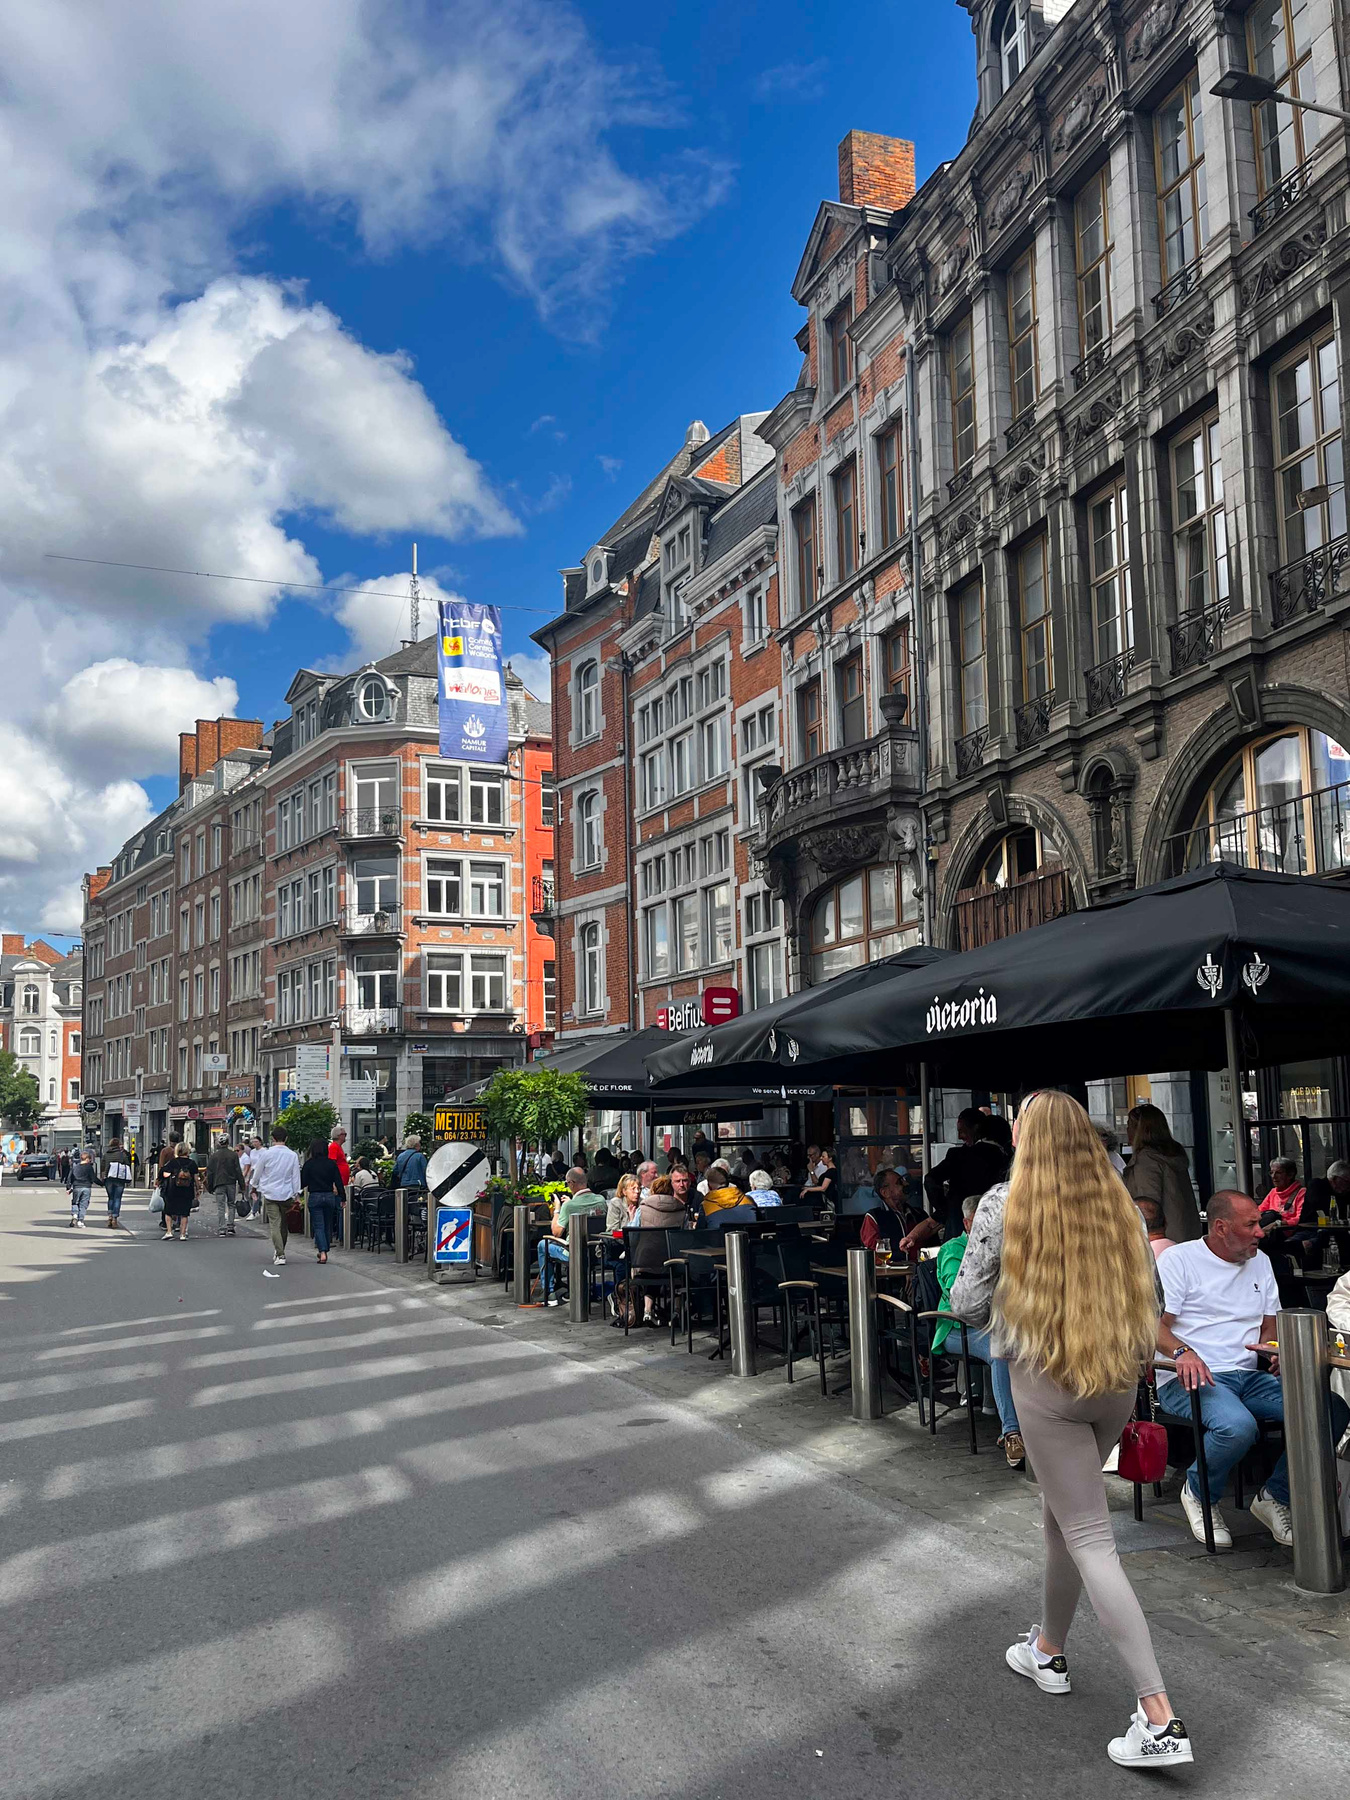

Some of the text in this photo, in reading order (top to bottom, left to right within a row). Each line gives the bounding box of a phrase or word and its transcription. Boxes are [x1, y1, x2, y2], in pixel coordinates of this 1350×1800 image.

[468, 643, 495, 652] Central
[469, 650, 498, 660] Wallonie
[461, 738, 487, 746] NAMUR
[461, 744, 487, 752] CAPITALE
[926, 987, 997, 1034] victoria
[435, 1112, 488, 1131] METUBEL
